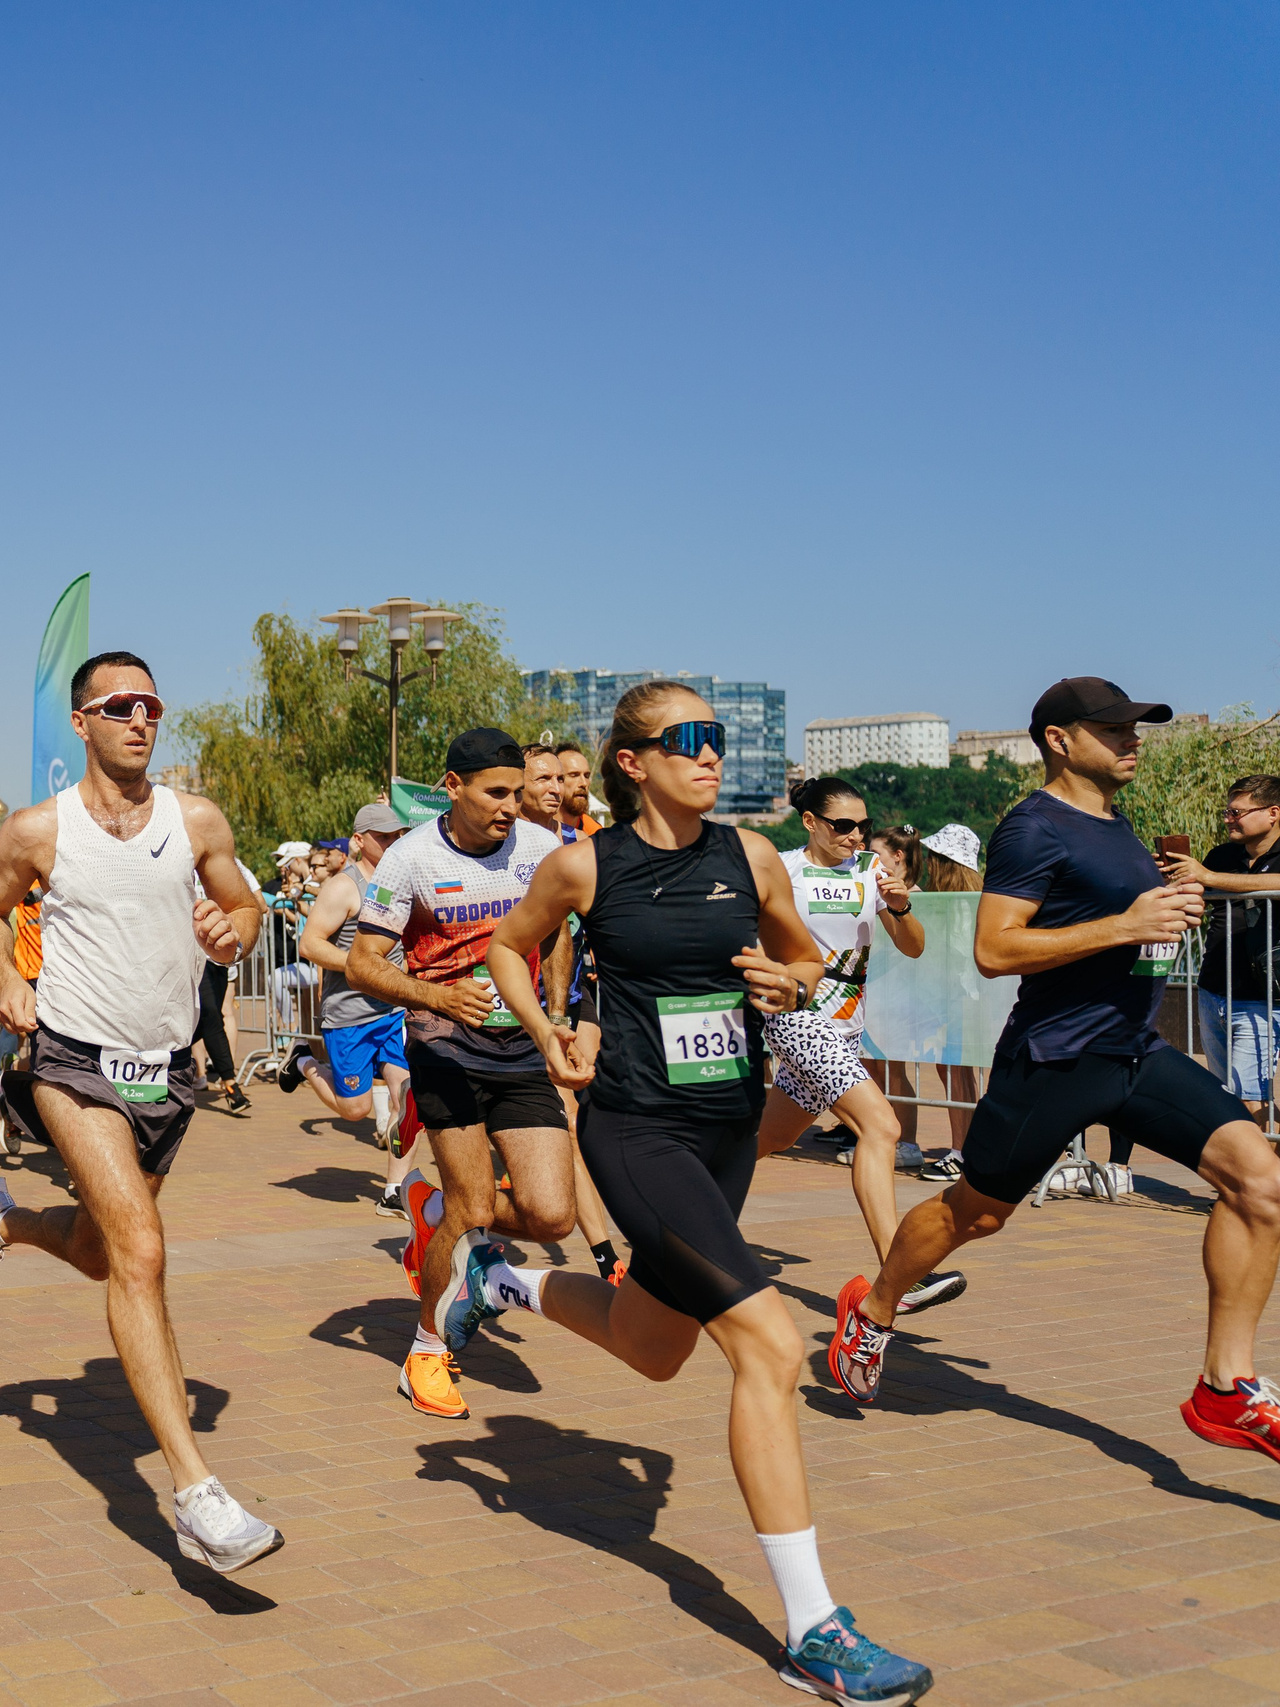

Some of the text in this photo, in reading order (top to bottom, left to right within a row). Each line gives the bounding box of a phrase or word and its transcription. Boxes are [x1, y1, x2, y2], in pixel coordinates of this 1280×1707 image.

[412, 792, 451, 803] Команда
[706, 892, 737, 900] DEMIX
[812, 887, 851, 900] 1847
[676, 1029, 739, 1060] 1836
[110, 1059, 163, 1082] 1077
[700, 1065, 726, 1077] 4,2км
